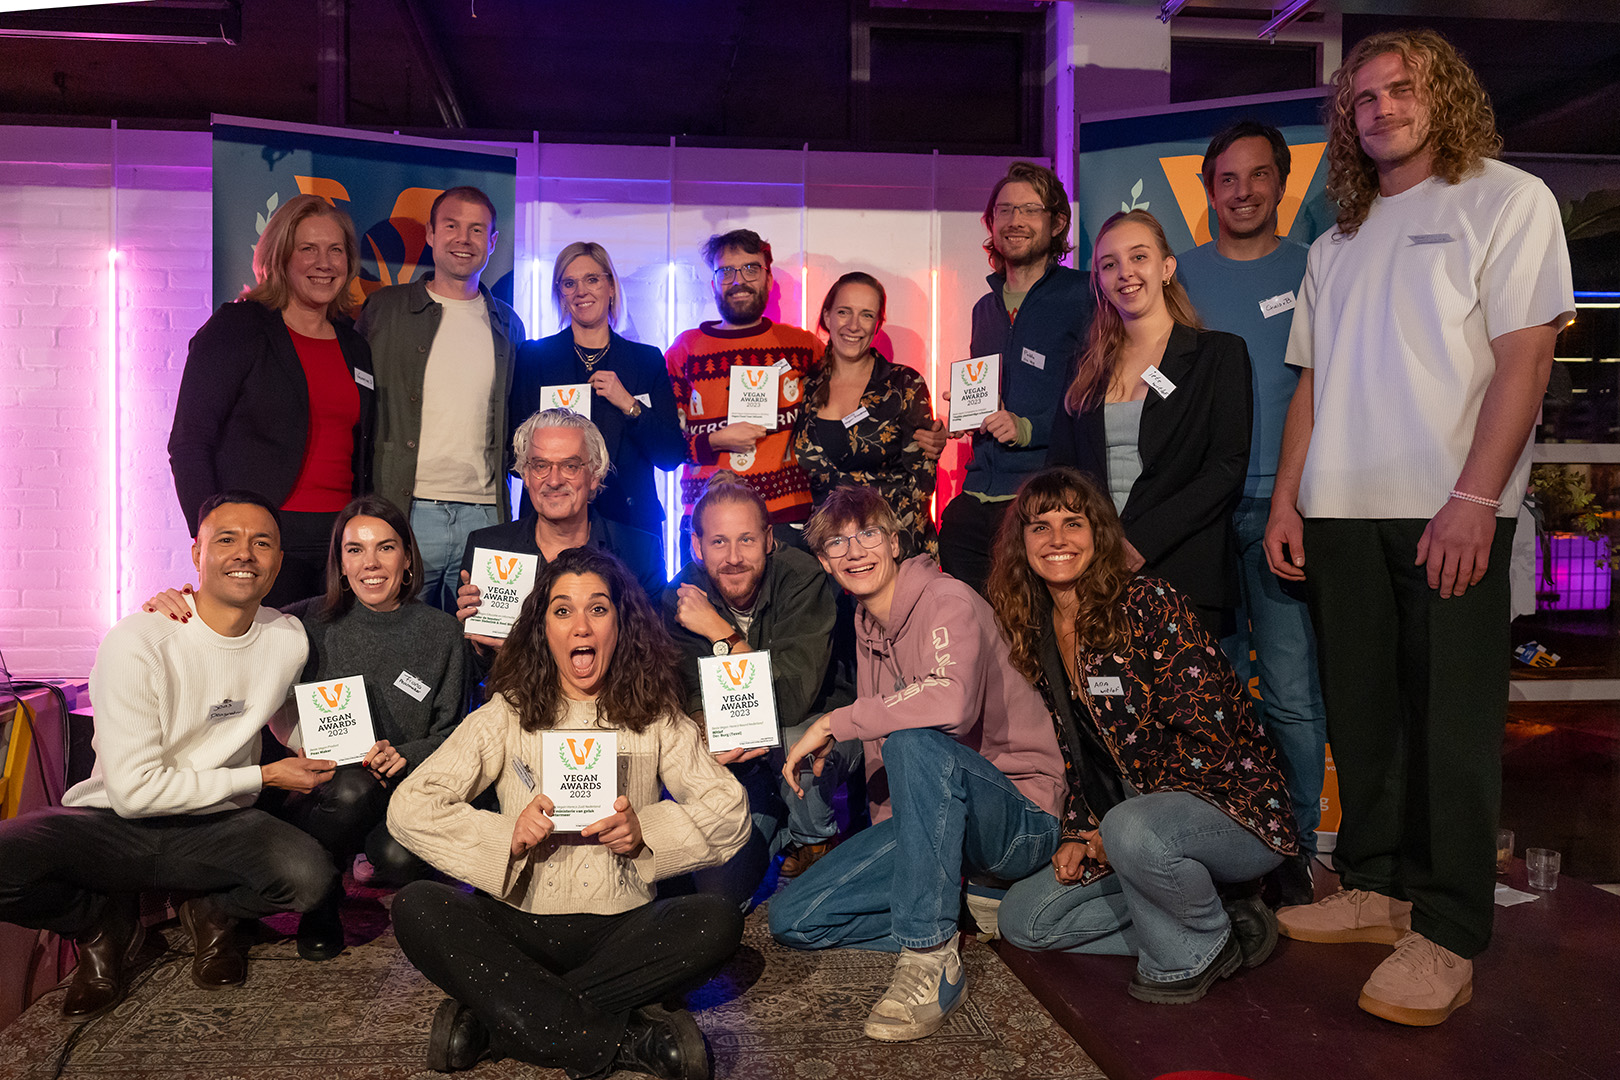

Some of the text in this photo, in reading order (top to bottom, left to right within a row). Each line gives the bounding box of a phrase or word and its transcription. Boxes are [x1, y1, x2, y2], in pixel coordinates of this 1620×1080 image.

[964, 386, 986, 394] VEGAN
[961, 392, 988, 401] AWARDS
[488, 586, 517, 596] VEGAN
[483, 592, 519, 603] AWARDS
[490, 601, 510, 609] 2023
[722, 693, 755, 702] VEGAN
[720, 700, 759, 711] AWARDS
[730, 709, 750, 718] 2023
[319, 713, 352, 724] VEGAN
[317, 718, 357, 732] AWARDS
[328, 728, 348, 737] 2023
